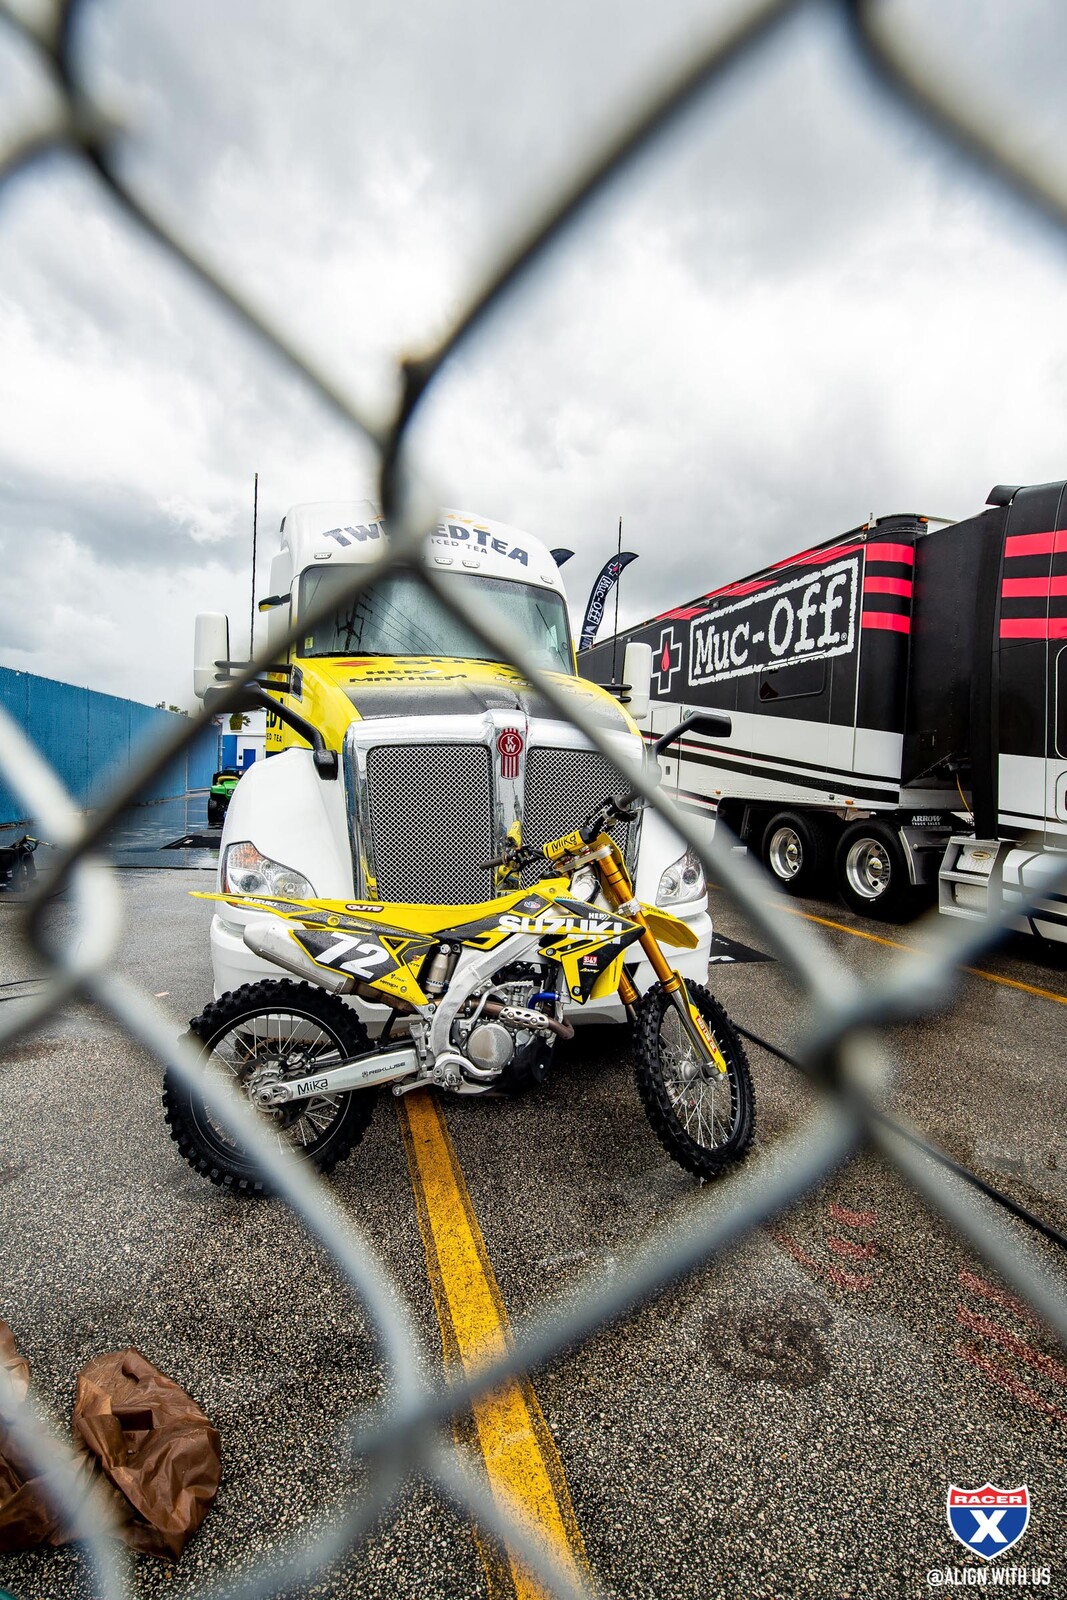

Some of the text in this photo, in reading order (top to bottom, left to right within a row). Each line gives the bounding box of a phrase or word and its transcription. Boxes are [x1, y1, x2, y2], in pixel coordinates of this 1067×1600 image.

[431, 538, 488, 554] ICED TEA
[472, 528, 529, 567] TEA
[694, 573, 847, 676] Muc-Off
[243, 896, 278, 907] SUZUKI
[498, 915, 623, 945] SUZUKI
[314, 931, 390, 981] 72
